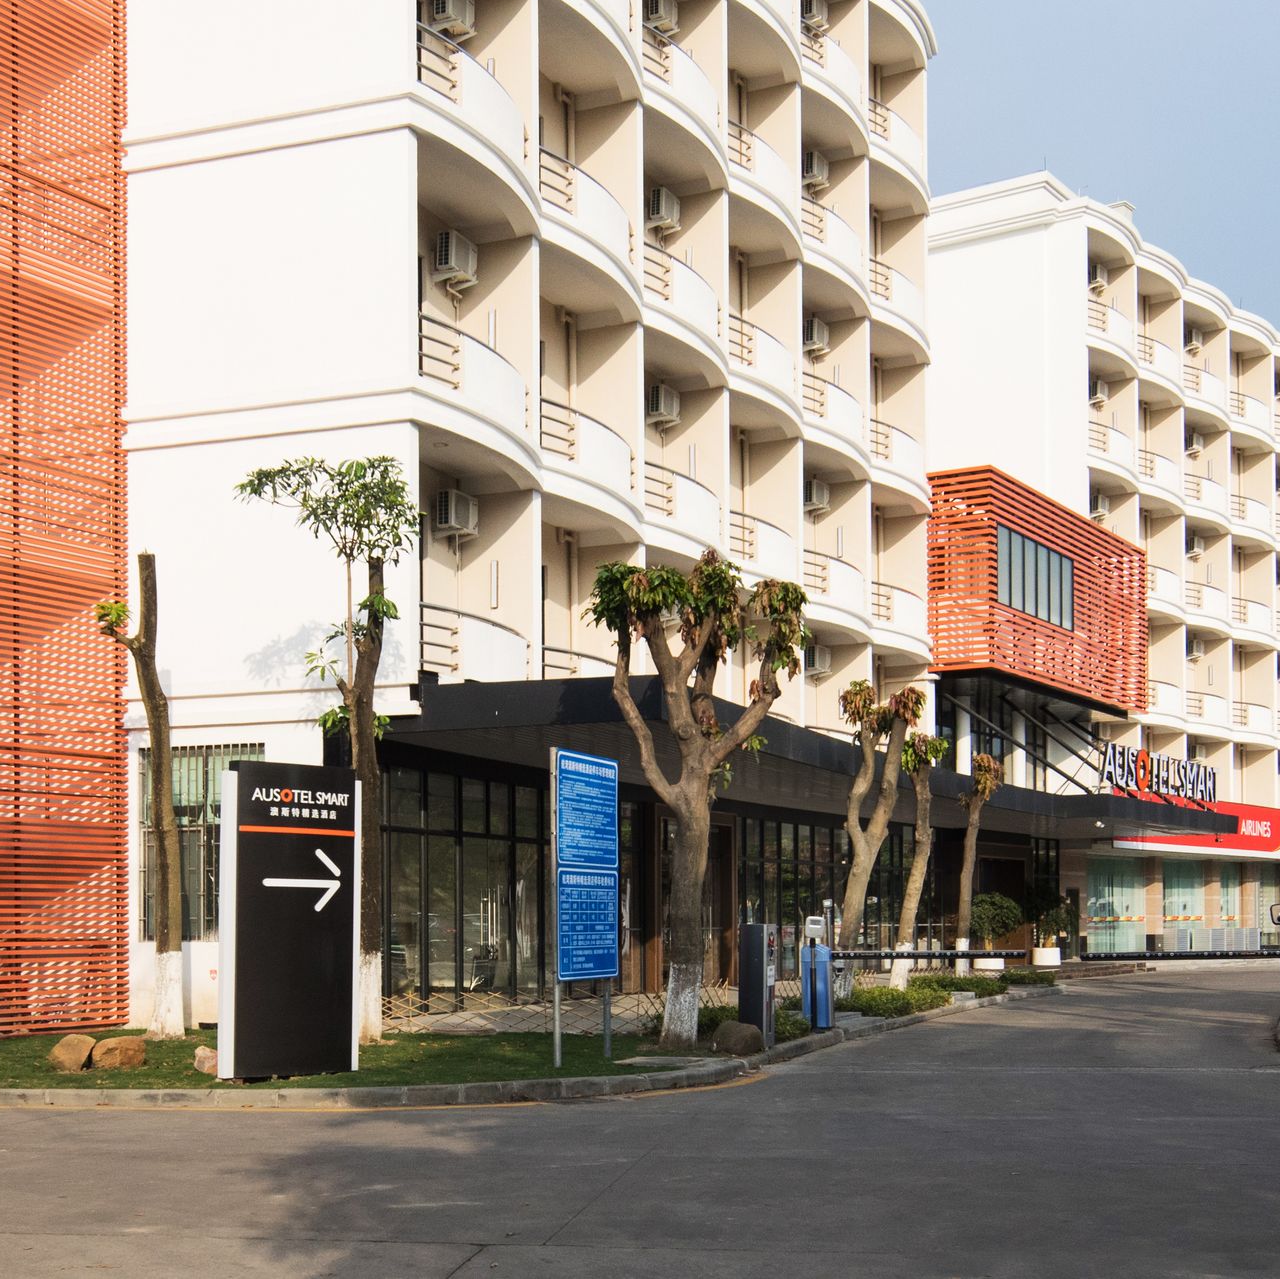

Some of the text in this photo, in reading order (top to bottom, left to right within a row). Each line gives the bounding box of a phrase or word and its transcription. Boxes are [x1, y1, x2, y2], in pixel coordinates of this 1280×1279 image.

[1102, 741, 1220, 803] AUSOTEL SMART
[251, 787, 350, 807] AUSOTEL SMART
[269, 806, 337, 820] 澳斯特精选酒店
[1240, 819, 1271, 838] AIRLINES
